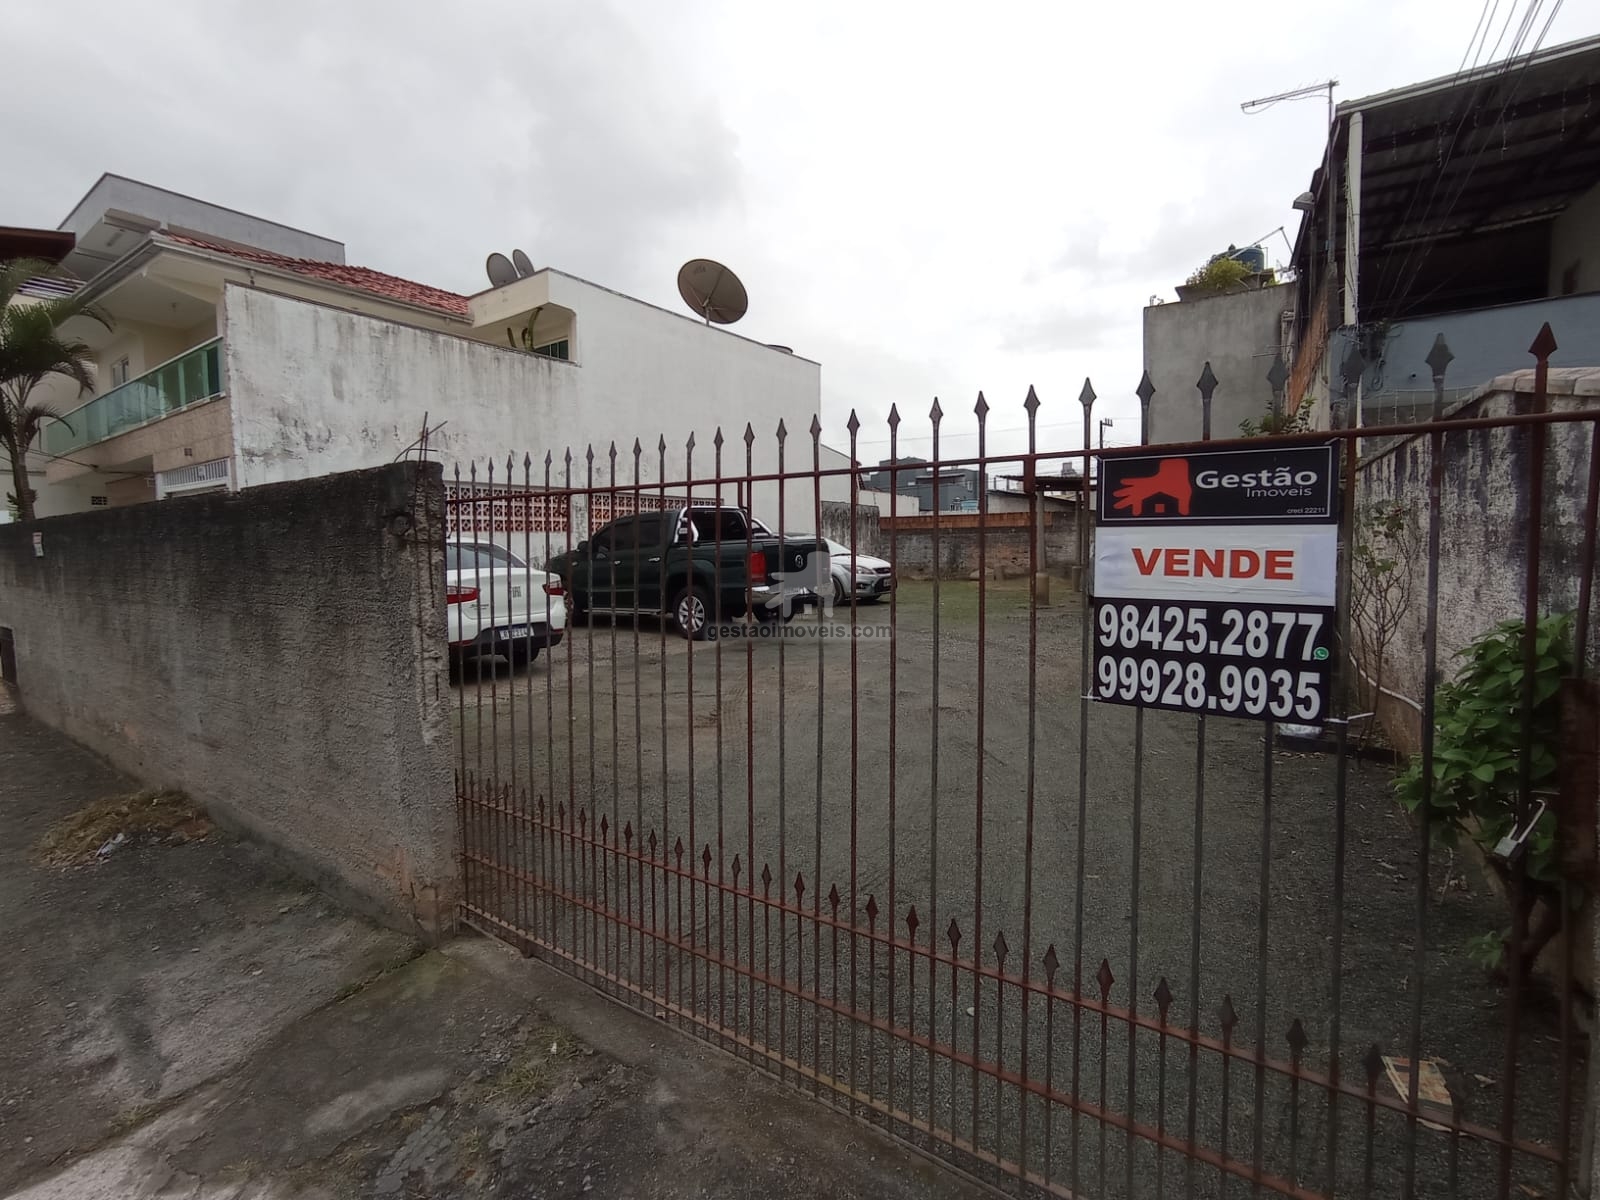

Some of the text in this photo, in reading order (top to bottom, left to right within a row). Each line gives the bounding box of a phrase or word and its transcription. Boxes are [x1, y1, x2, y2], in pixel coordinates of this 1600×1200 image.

[1195, 466, 1318, 489] Gestão
[1246, 486, 1313, 498] Imoveis
[1131, 548, 1294, 580] VENDE
[1099, 603, 1323, 661] 98425.2877
[1098, 655, 1321, 720] 99928.9935
